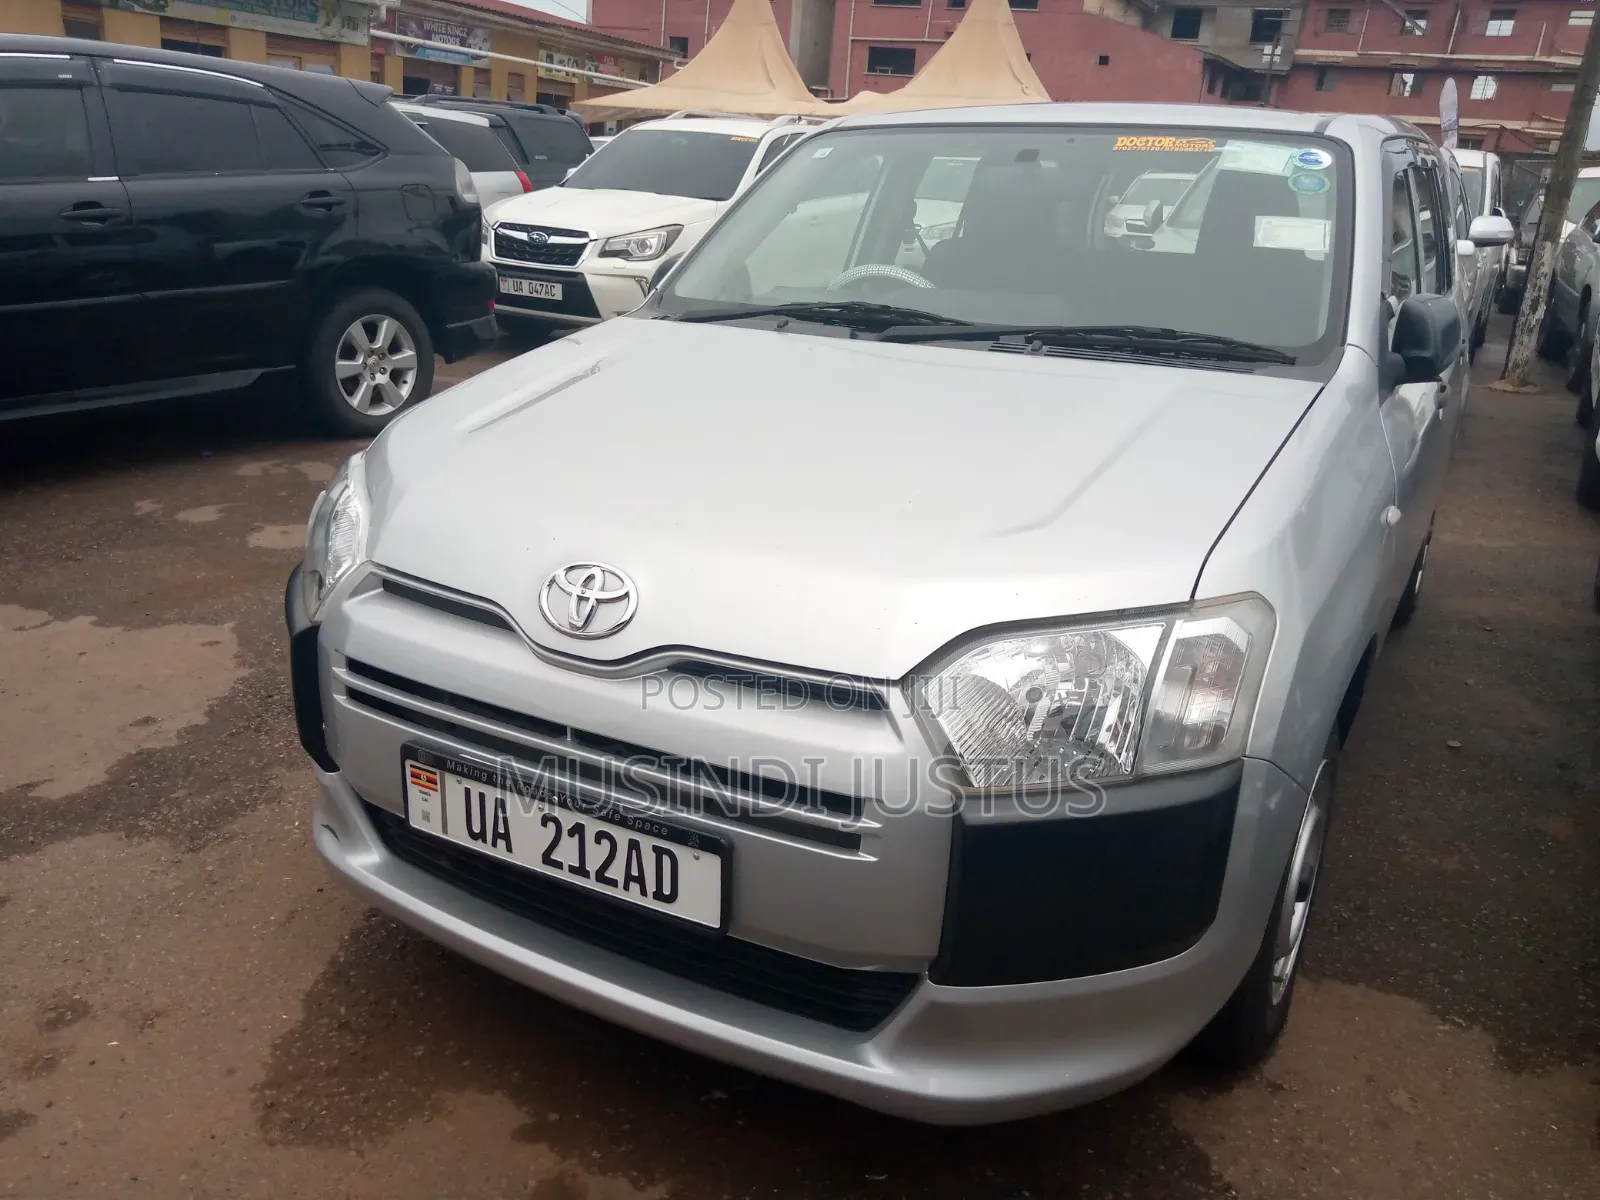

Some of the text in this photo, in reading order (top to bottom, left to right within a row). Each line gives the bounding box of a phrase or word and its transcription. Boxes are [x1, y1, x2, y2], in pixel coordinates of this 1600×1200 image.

[424, 20, 468, 38] WHITE KINGZ
[432, 33, 460, 46] MOTORS
[1116, 136, 1175, 147] DOCTOR
[513, 280, 555, 297] UA 047AC
[446, 759, 668, 836] Making the Roads Your Safe Space
[464, 787, 679, 904] UA 212AD
